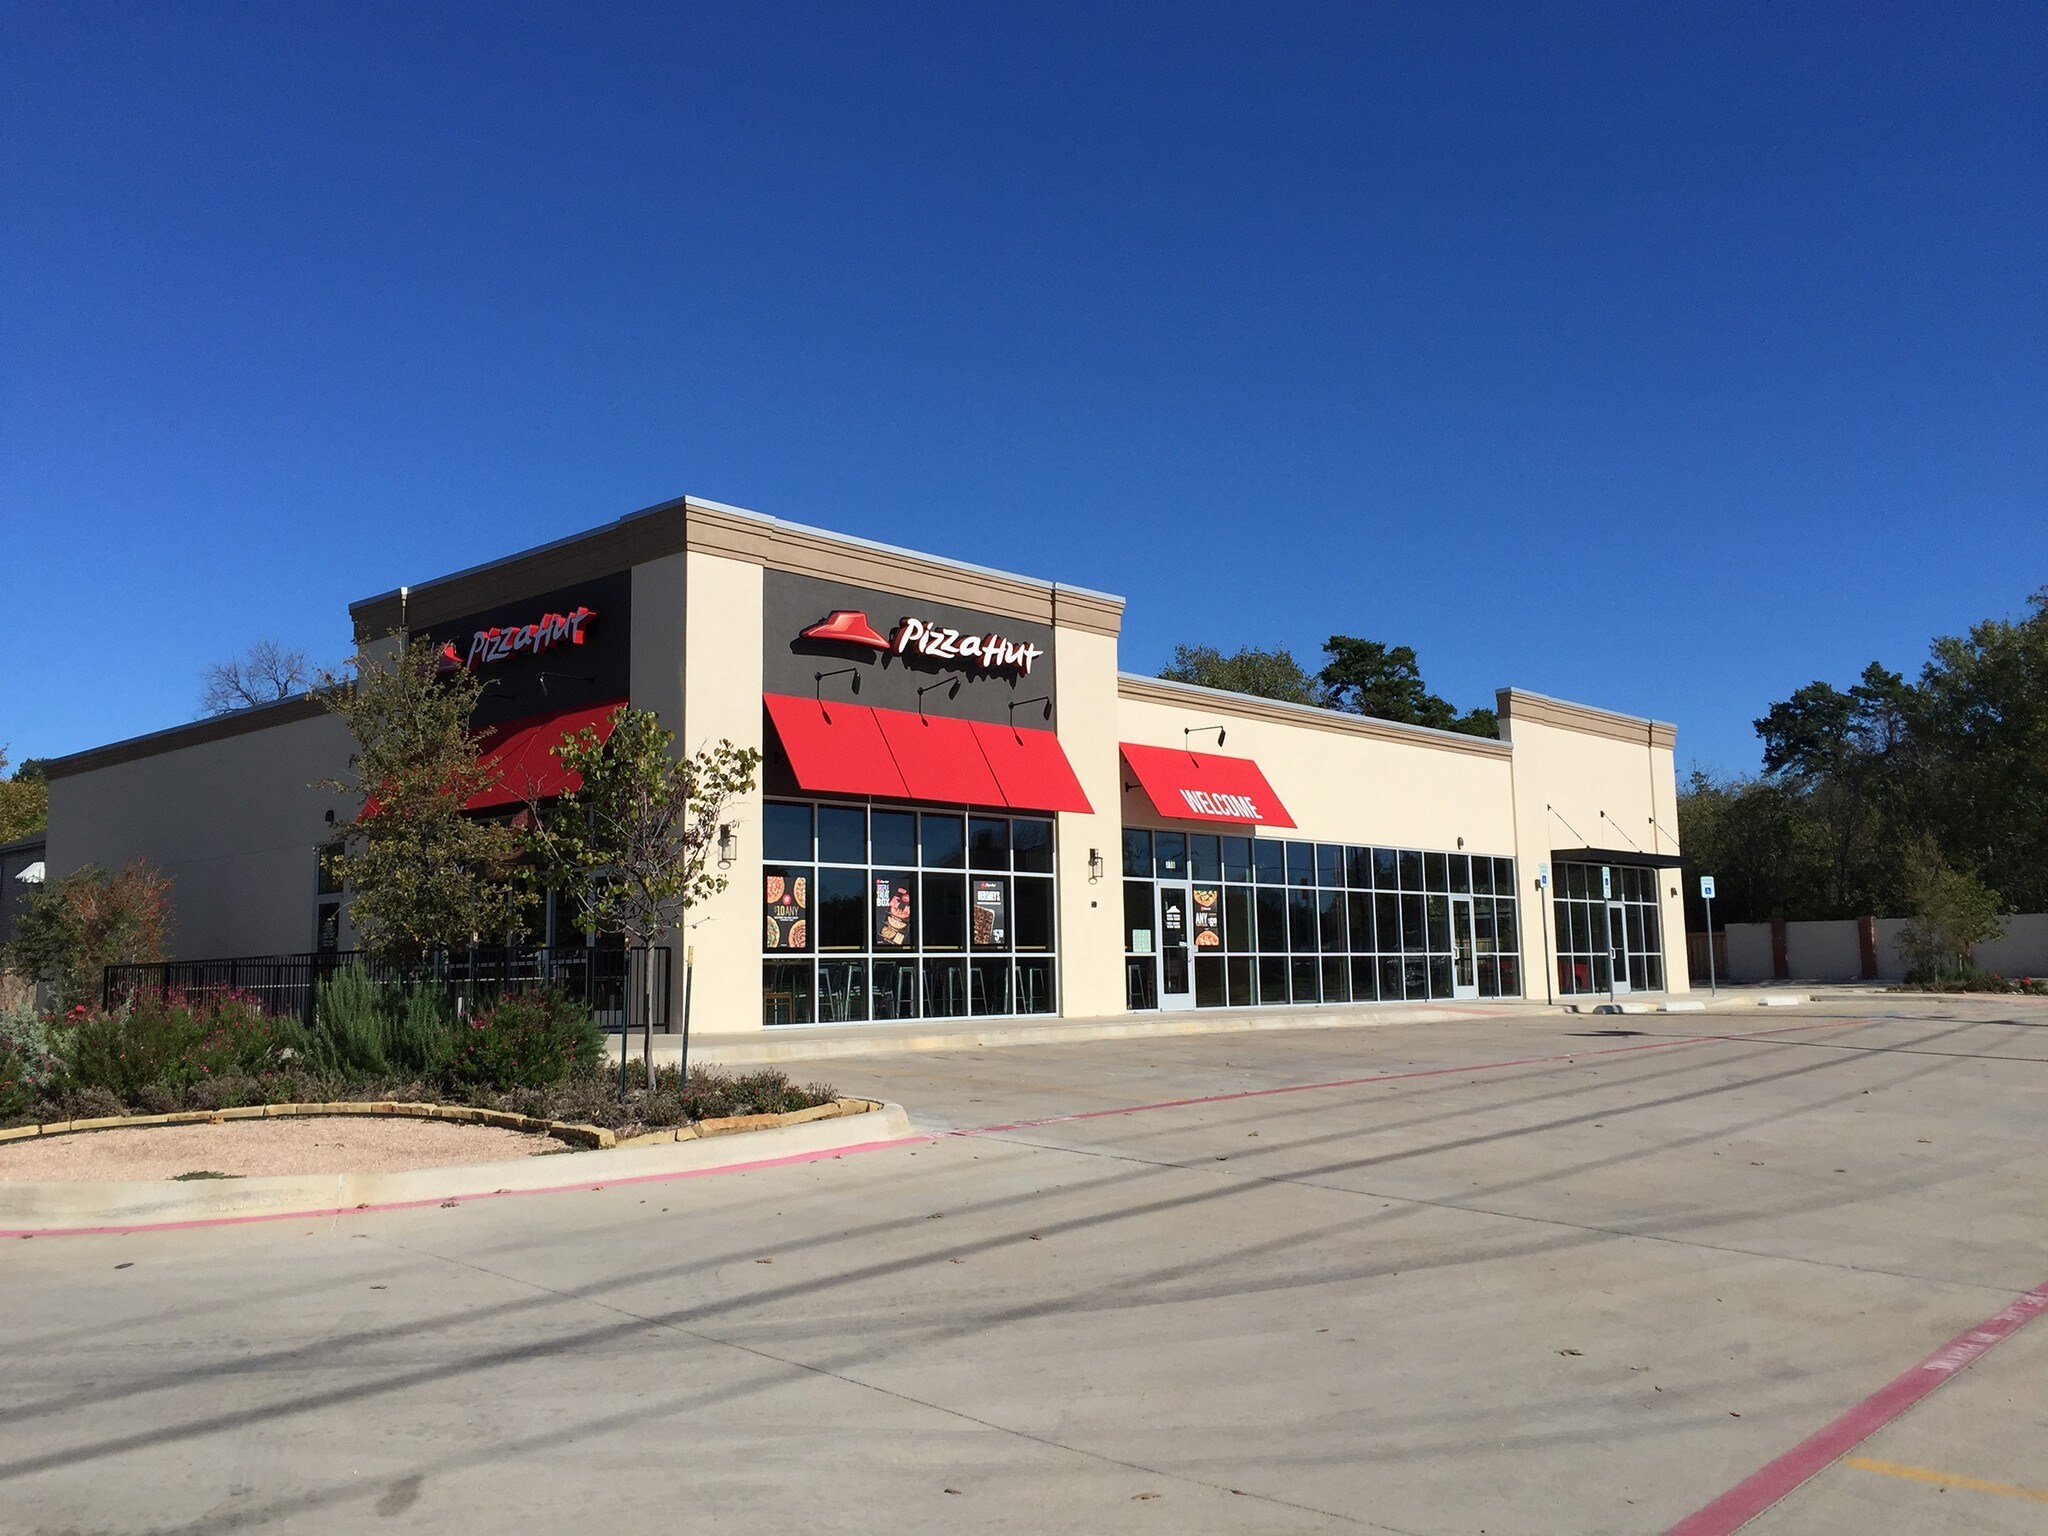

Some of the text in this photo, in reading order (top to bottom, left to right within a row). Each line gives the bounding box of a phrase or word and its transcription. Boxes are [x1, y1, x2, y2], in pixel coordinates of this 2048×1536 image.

[467, 607, 597, 668] Pizza Hut
[899, 618, 1043, 674] Pizza Hut
[1179, 788, 1263, 819] WELCOME
[785, 905, 799, 916] ANY
[1195, 912, 1208, 924] ANY
